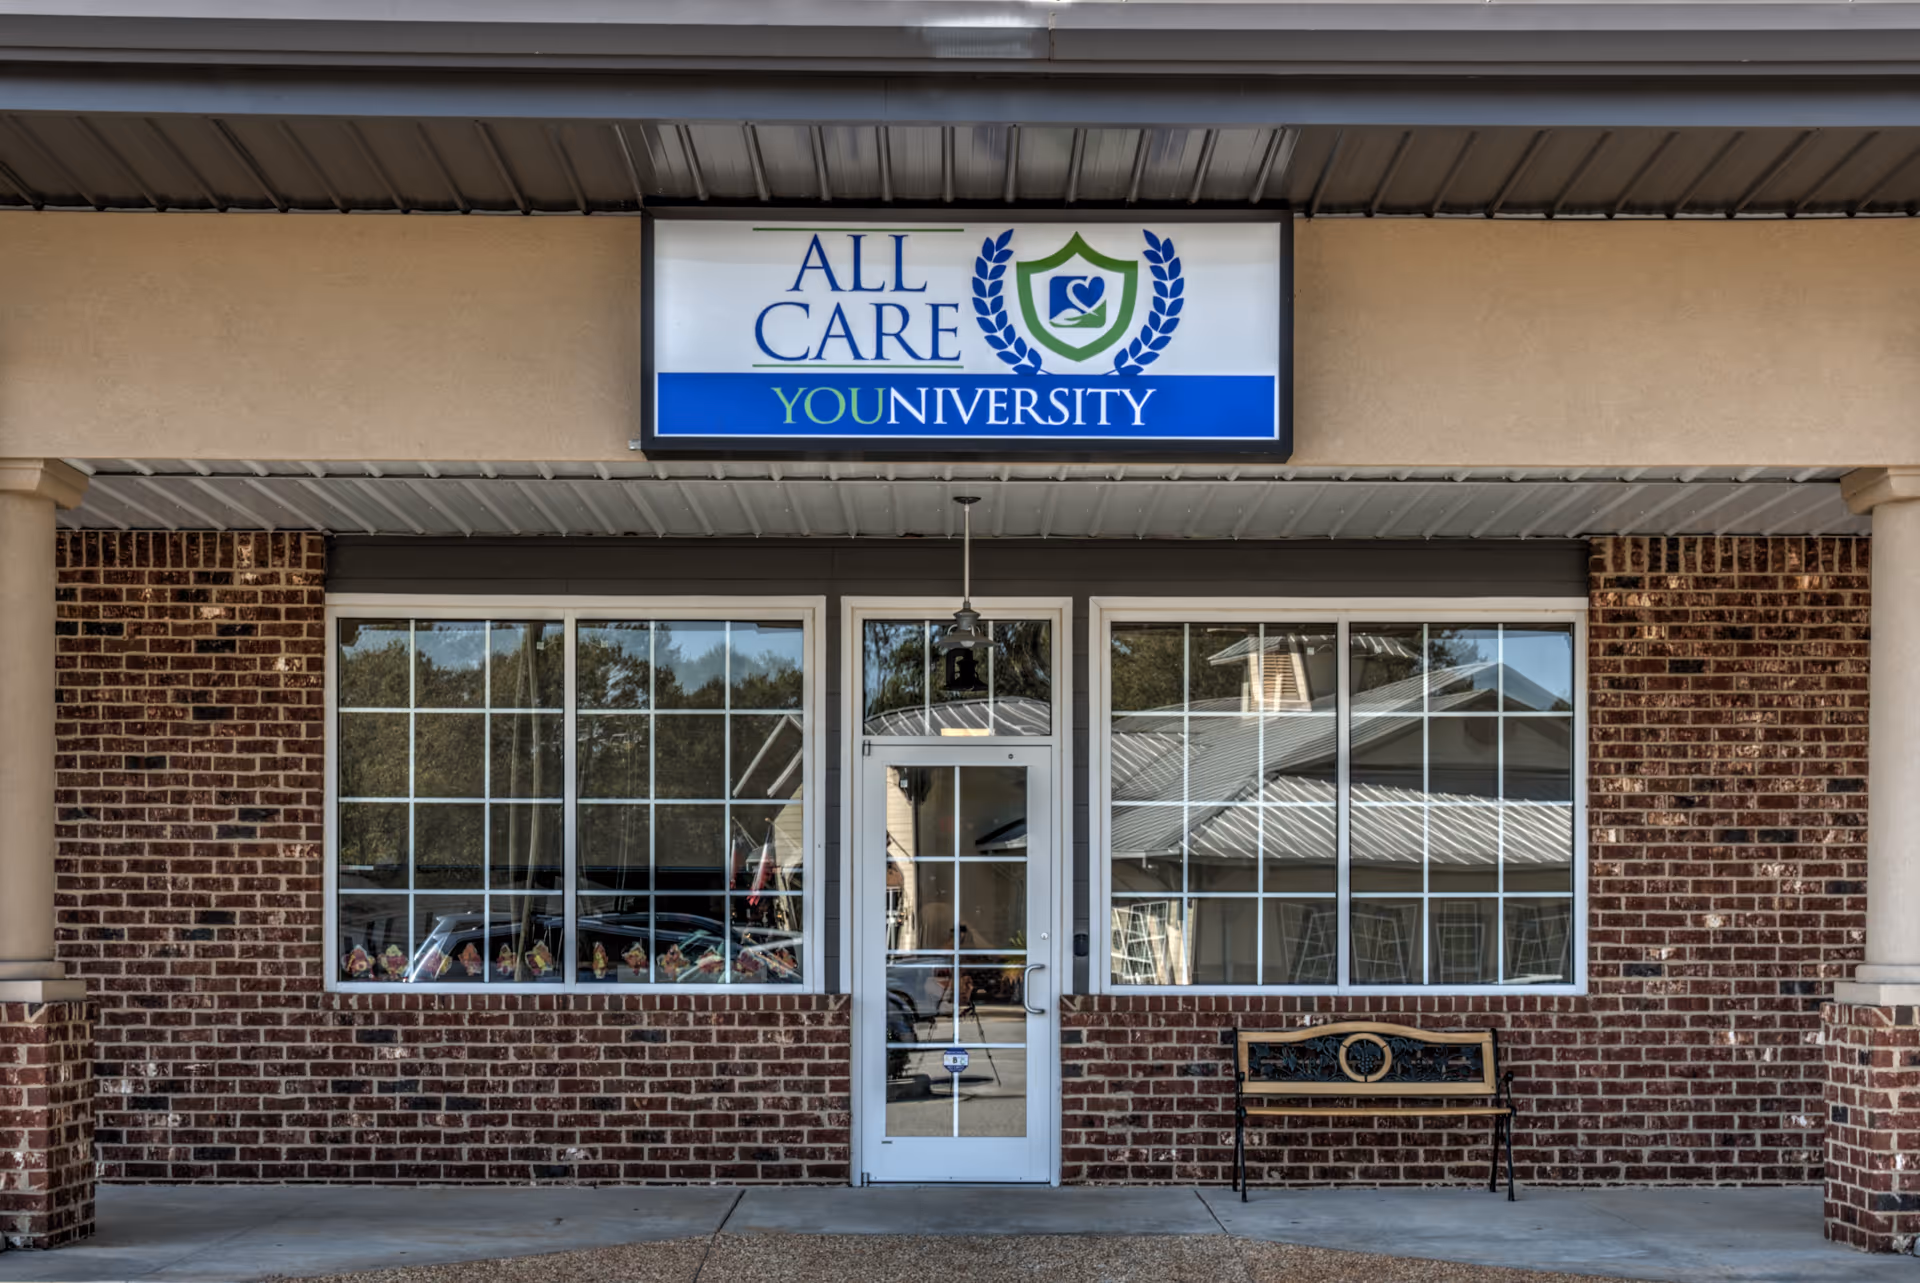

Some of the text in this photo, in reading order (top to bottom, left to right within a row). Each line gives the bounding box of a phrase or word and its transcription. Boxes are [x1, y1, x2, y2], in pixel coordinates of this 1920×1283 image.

[786, 233, 928, 293] ALL
[754, 301, 962, 362] CARE
[771, 386, 1158, 426] YOUNIVERSITY
